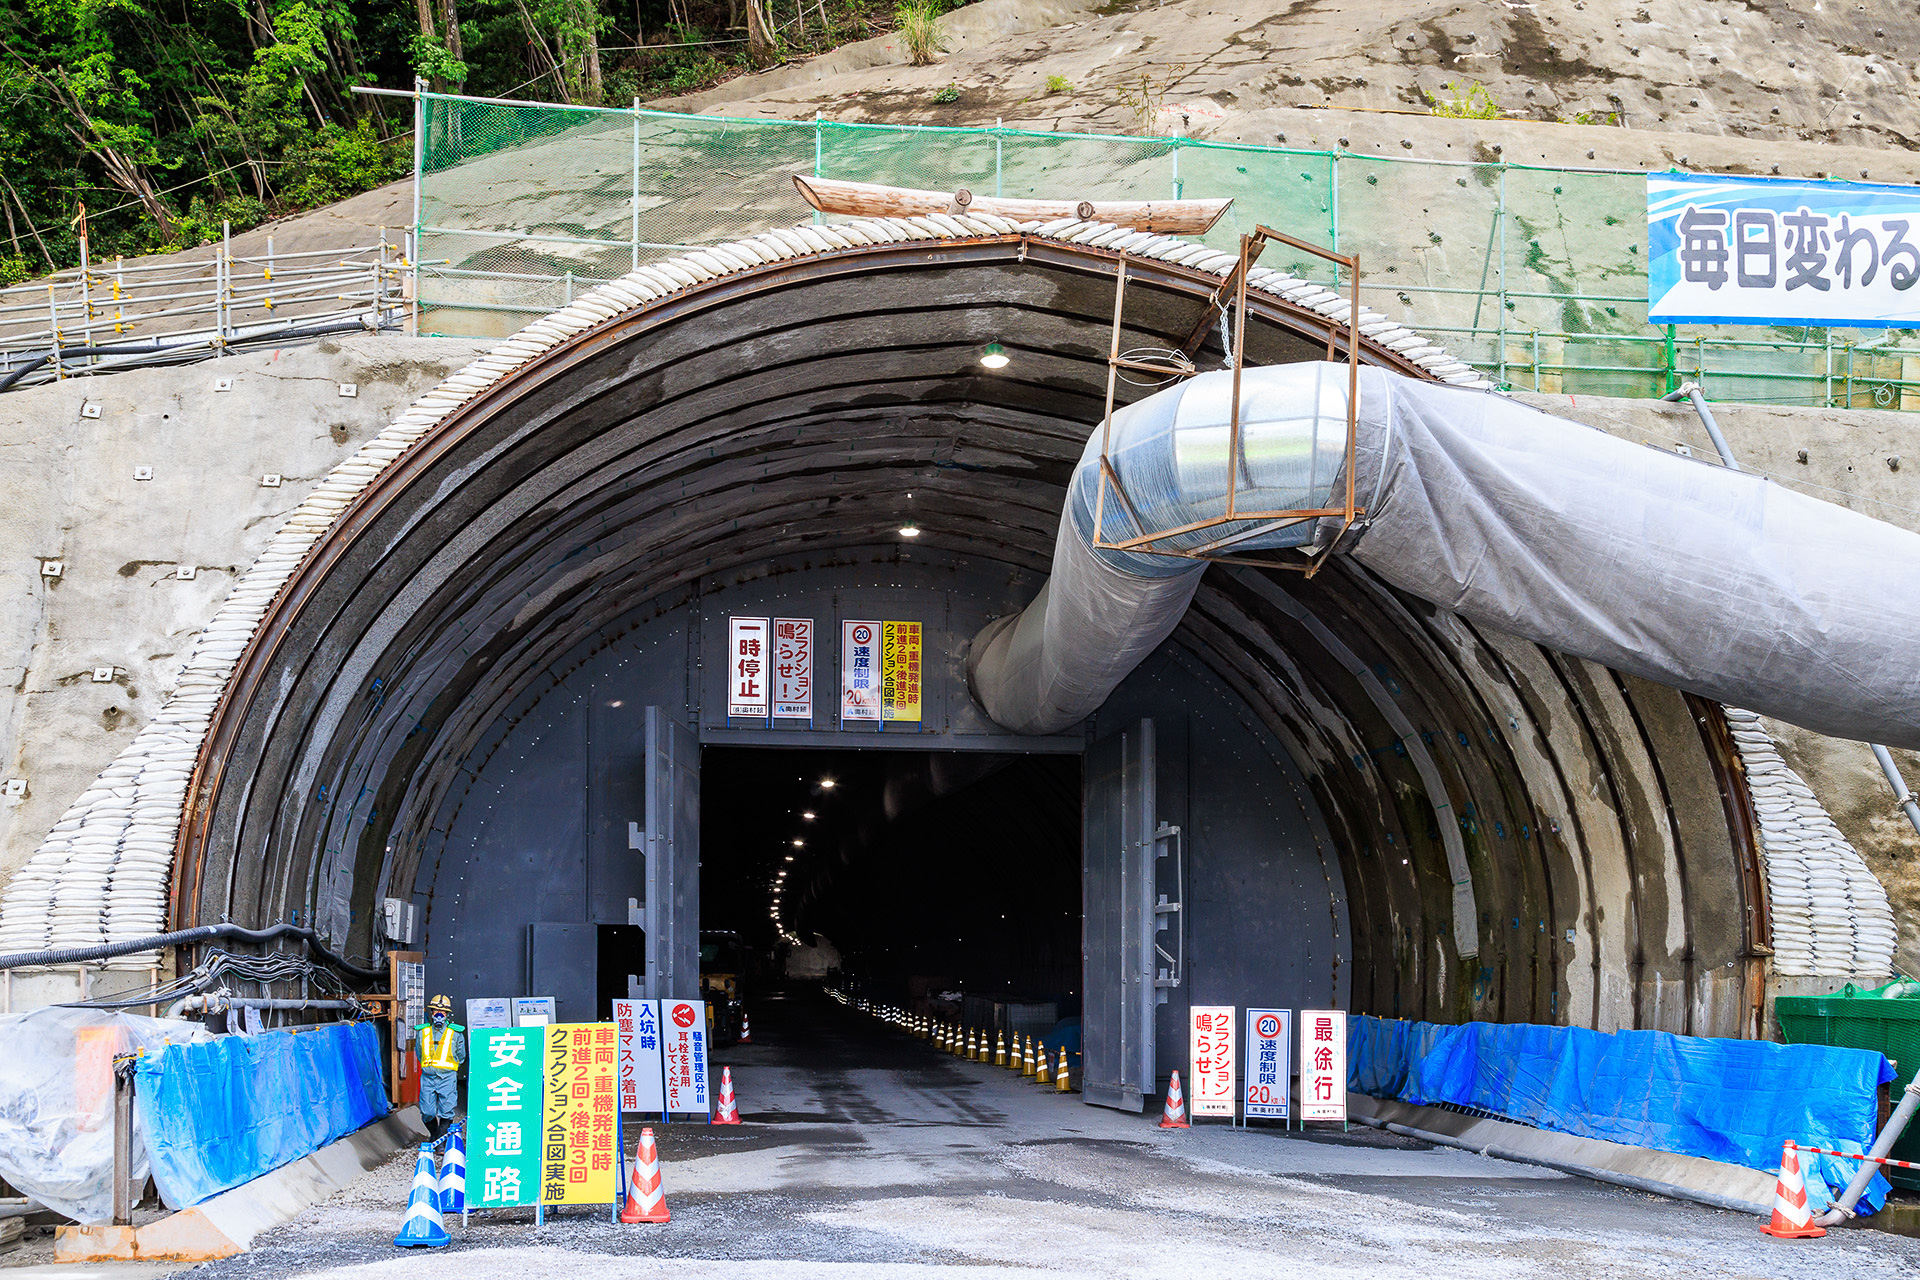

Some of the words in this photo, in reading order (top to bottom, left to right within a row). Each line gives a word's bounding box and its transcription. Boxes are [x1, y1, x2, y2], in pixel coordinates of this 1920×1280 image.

[1679, 206, 1920, 291] 毎日変わる
[738, 625, 761, 698] 一時停止
[777, 623, 795, 698] 鳴らせ！
[794, 622, 809, 700] クラクション
[853, 646, 870, 690] 速度制限
[856, 629, 868, 640] 20
[884, 623, 895, 719] クラクション合図実施
[896, 624, 908, 710] 前進2回・後進3回
[908, 624, 919, 705] 車両・重機発進時
[617, 1003, 637, 1109] 防塵マスク着用
[639, 1004, 656, 1051] 入坑時
[677, 1031, 691, 1088] 耳栓を着用
[1196, 1013, 1212, 1095] 鳴らせ！
[1214, 1013, 1230, 1096] クラクション
[1259, 1039, 1277, 1085] 速度制限
[1261, 1019, 1276, 1033] 20
[1314, 1017, 1333, 1101] 最徐行
[544, 1028, 568, 1201] クラクション合図実施
[569, 1027, 592, 1184] 前進2回・後進3回
[592, 1027, 615, 1171] 車両・重機発進時
[667, 1043, 681, 1109] してください
[482, 1032, 525, 1202] 安全通路
